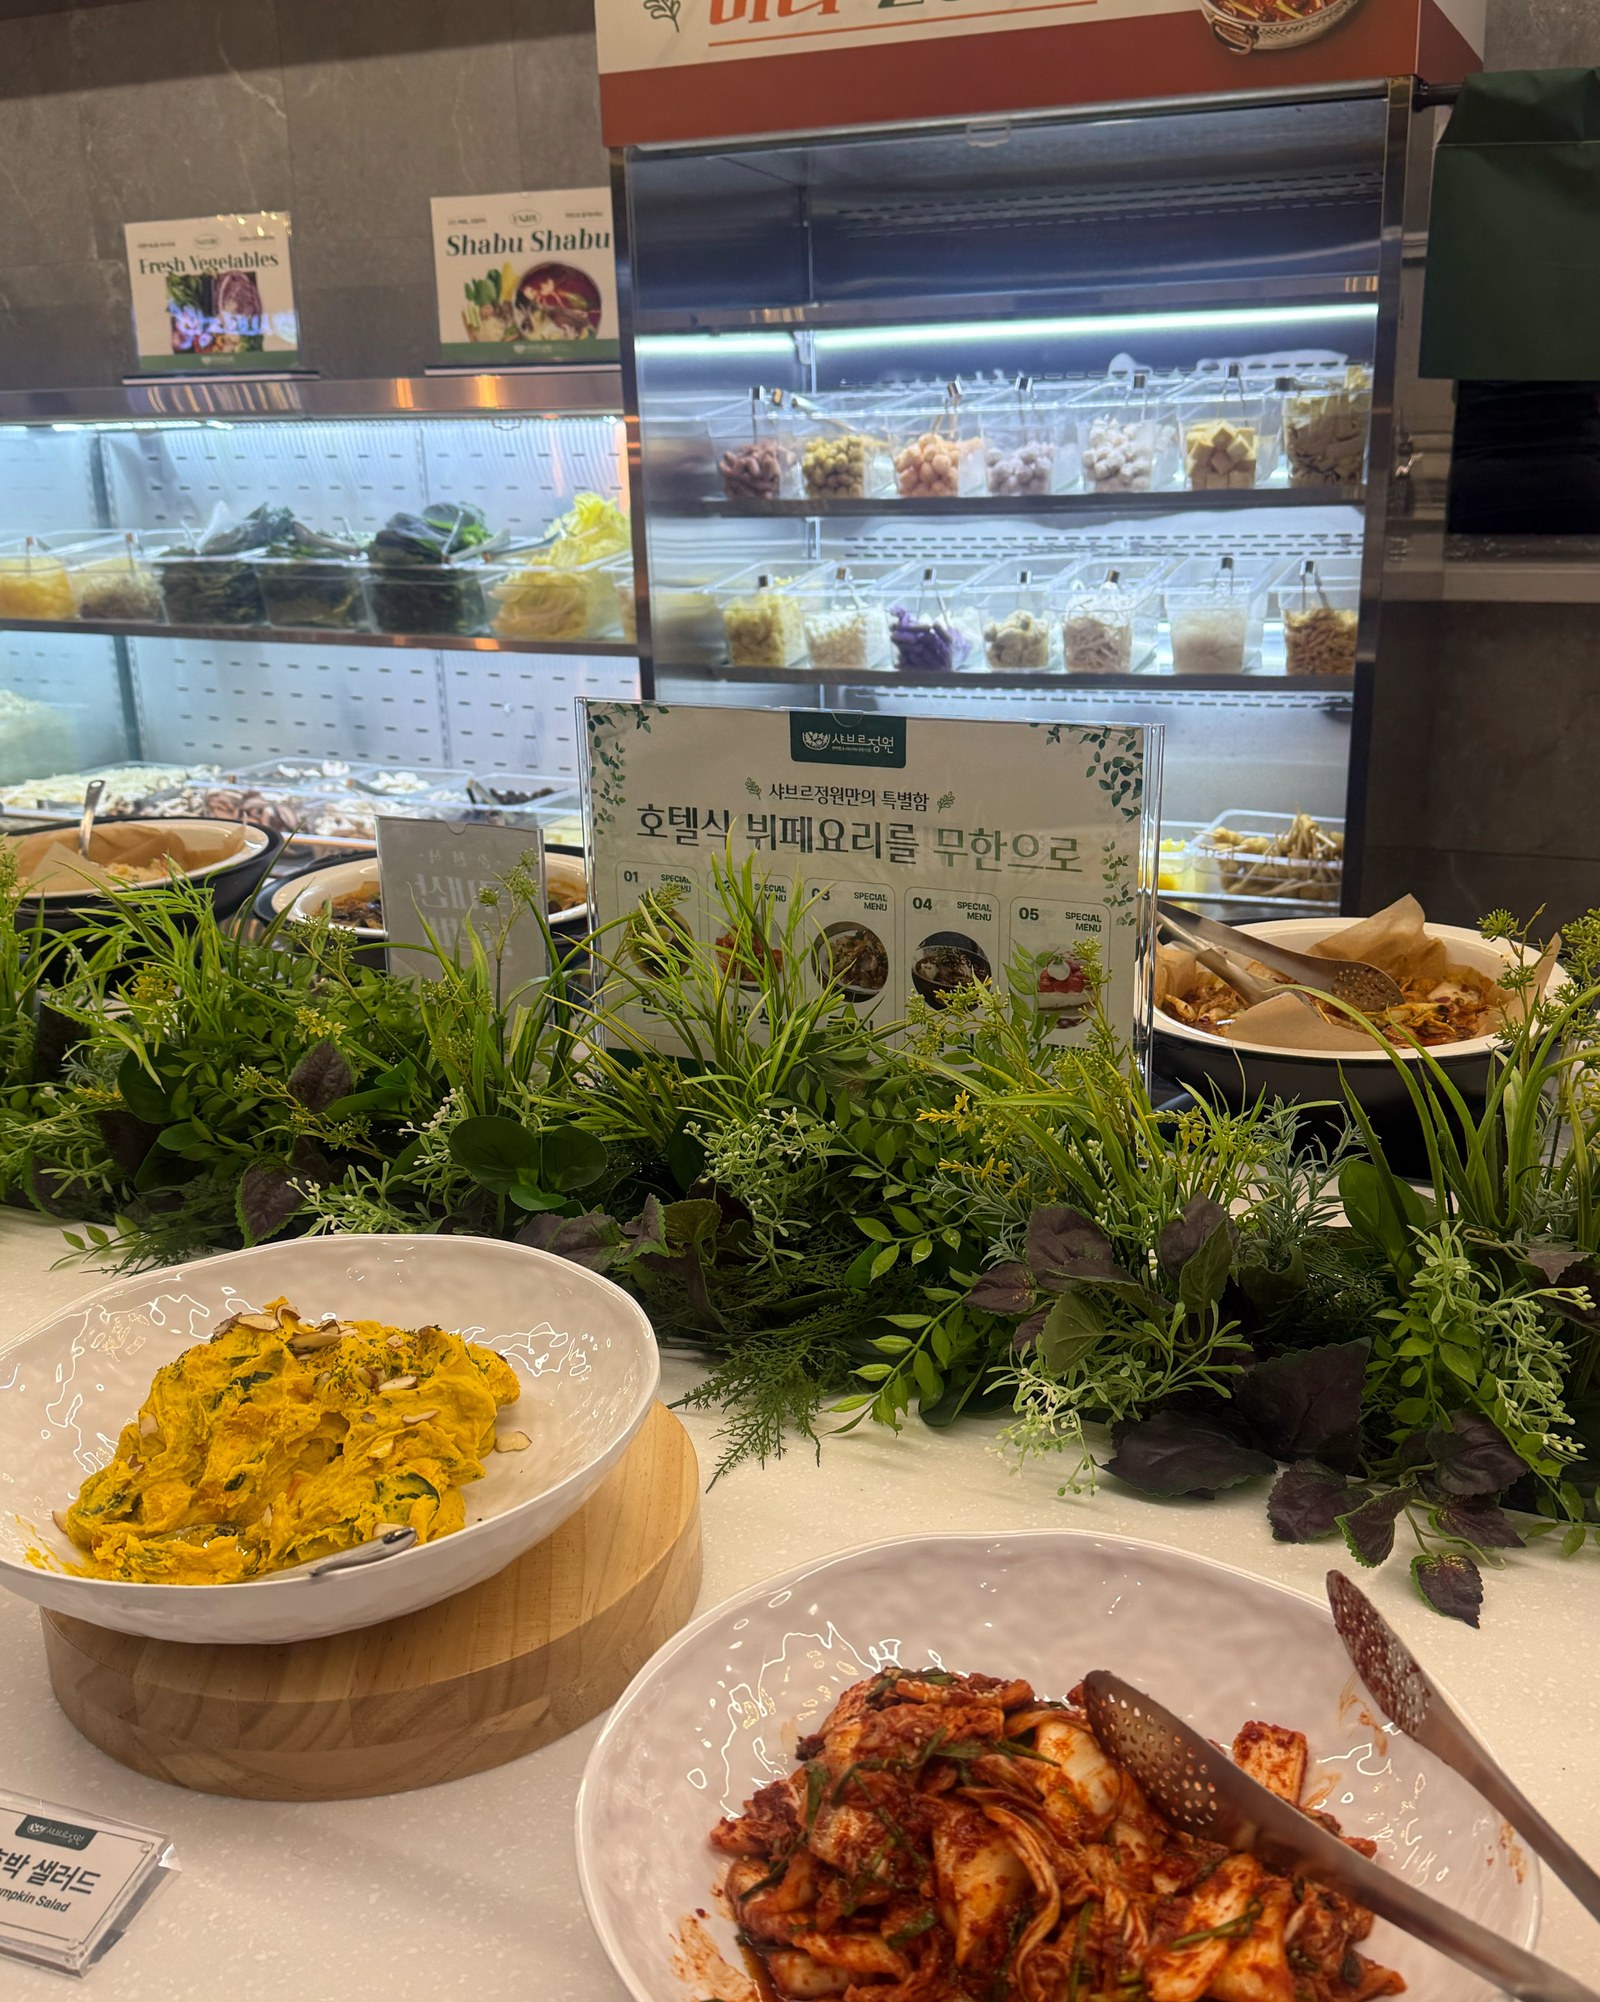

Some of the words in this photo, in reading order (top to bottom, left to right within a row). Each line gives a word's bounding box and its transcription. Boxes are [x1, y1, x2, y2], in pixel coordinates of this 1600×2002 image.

[446, 232, 523, 257] Shabu
[530, 228, 610, 253] Shabu
[139, 256, 185, 275] Fresh
[190, 251, 279, 273] Vegetables
[832, 733, 894, 754] 샤브르정원
[769, 783, 875, 807] 샤브르정원만의
[881, 790, 929, 812] 특별함
[637, 803, 730, 850] 호텔식
[746, 813, 919, 865] 뷔페요리를
[933, 827, 1083, 873] 무한으로
[623, 870, 639, 883] 01
[661, 874, 692, 884] SPECIAL
[754, 883, 787, 894] SECIAL
[811, 888, 830, 901] 03
[764, 892, 787, 903] MNU
[854, 891, 888, 902] SPECIAL
[863, 902, 888, 912] MENU
[912, 897, 933, 910] 04
[957, 901, 992, 912] SPECIAL
[967, 911, 992, 922] MENU
[1018, 907, 1040, 921] 05
[1065, 911, 1102, 923] SPECIAL
[1075, 922, 1102, 933] MENU
[26, 1859, 101, 1895] 샐러드
[36, 1895, 71, 1913] Salad
